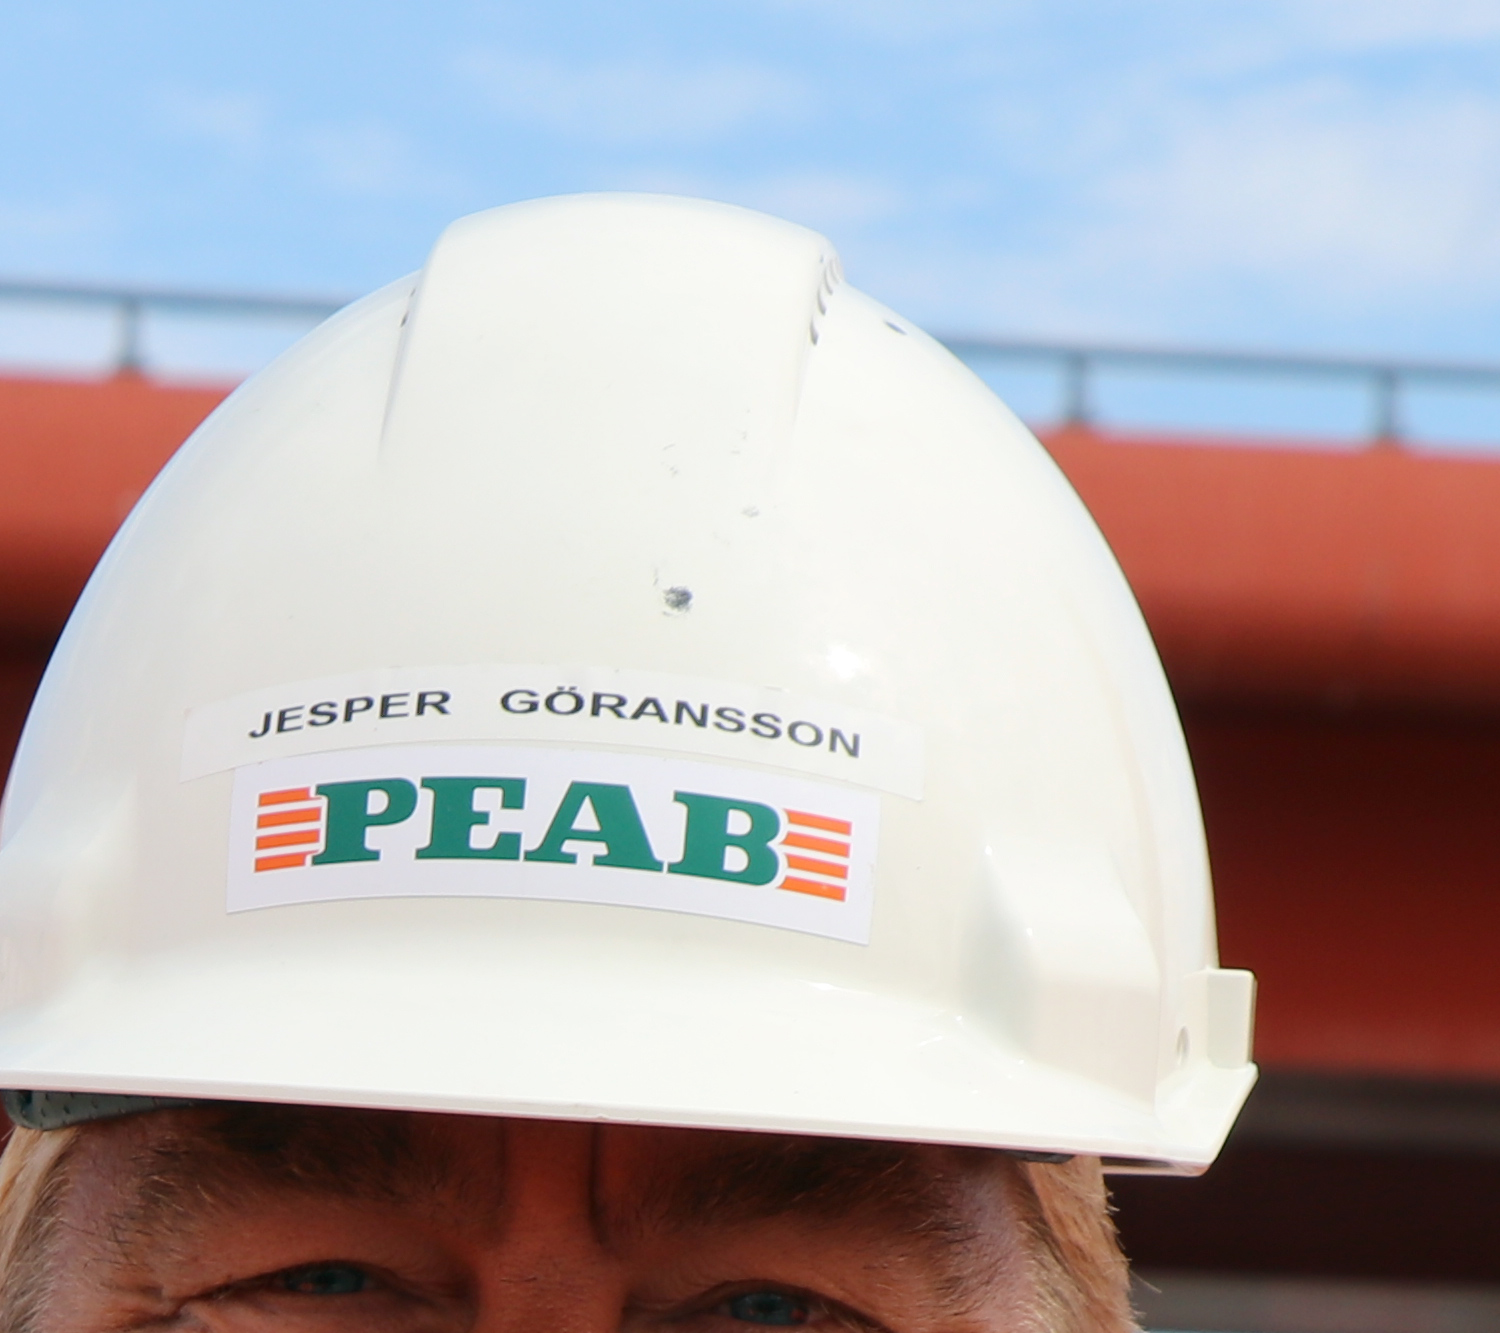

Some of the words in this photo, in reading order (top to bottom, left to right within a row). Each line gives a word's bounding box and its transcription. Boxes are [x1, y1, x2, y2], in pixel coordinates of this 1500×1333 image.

[248, 690, 452, 739] JESPER
[500, 685, 861, 759] GÖRANSSON
[311, 776, 782, 887] PEAB
